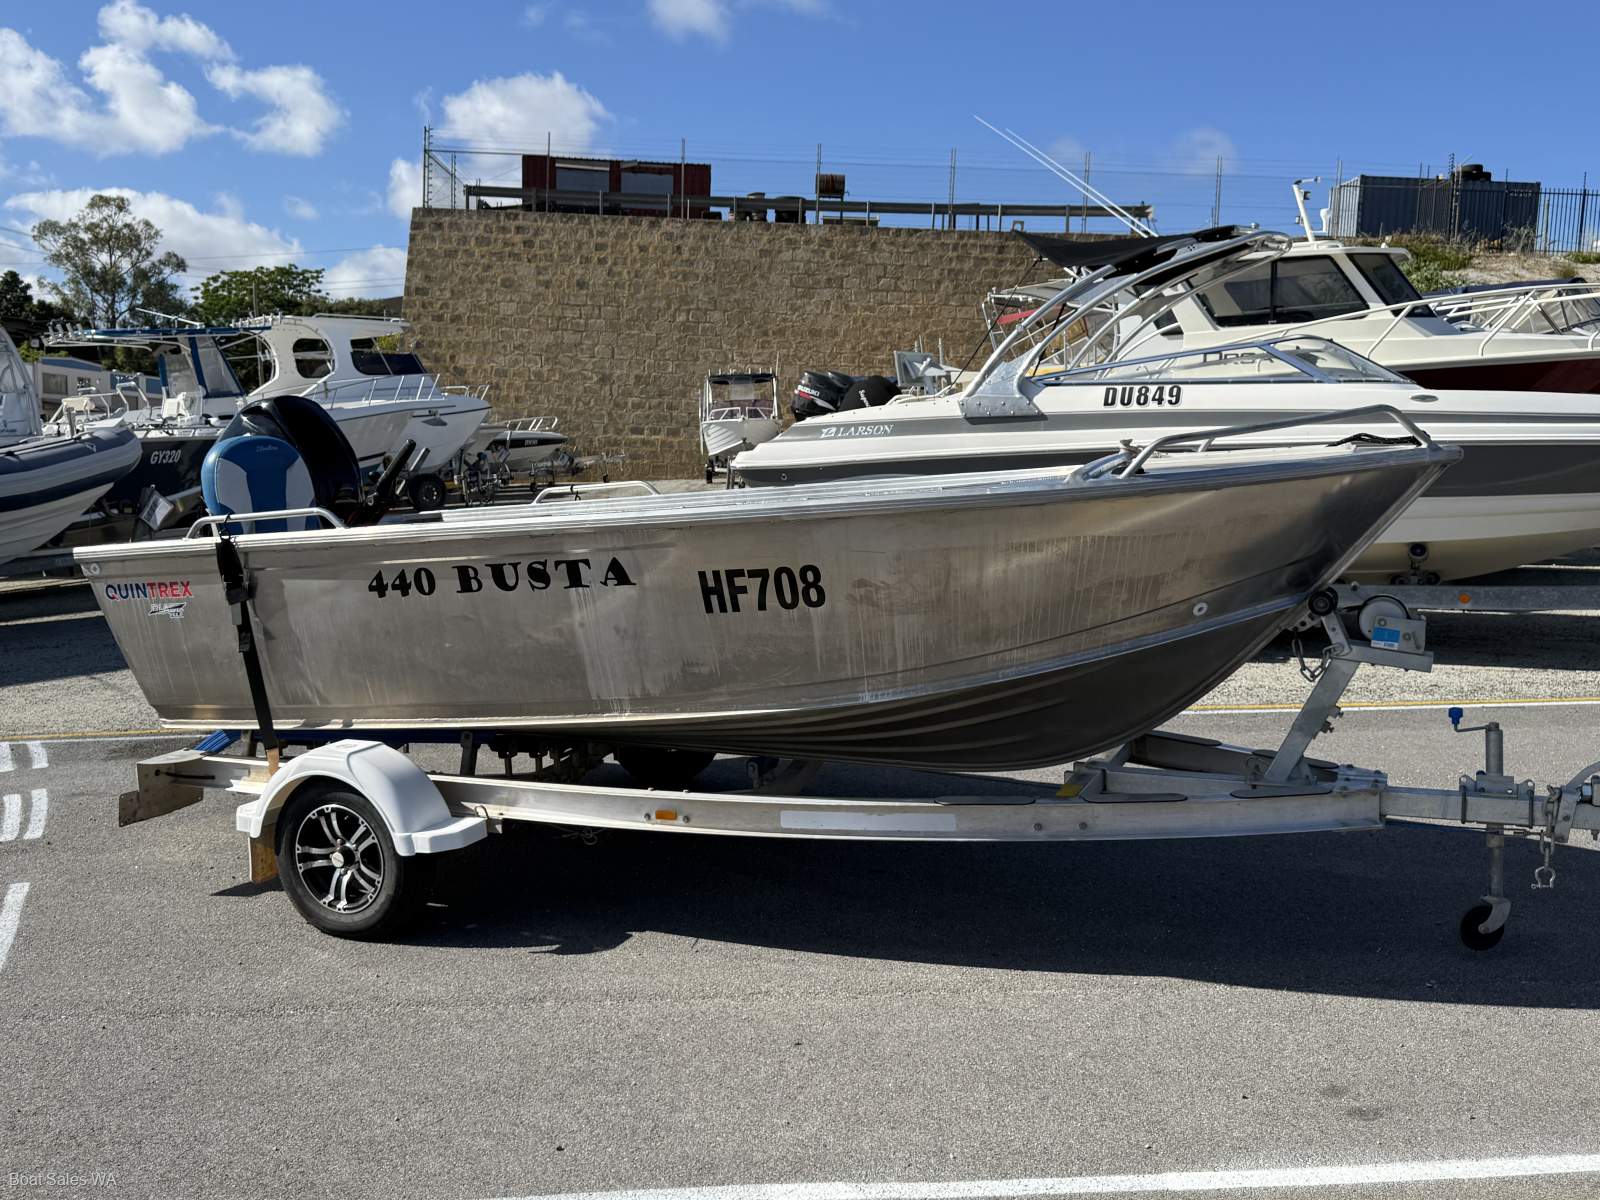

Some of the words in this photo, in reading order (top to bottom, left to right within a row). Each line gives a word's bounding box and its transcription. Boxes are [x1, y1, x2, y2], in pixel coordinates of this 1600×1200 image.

[1103, 385, 1182, 407] DU849
[838, 425, 894, 437] LARSON
[150, 449, 182, 465] GY320
[368, 567, 436, 598] 440
[452, 557, 636, 594] BUSTA
[105, 581, 193, 600] QUINTREX
[698, 564, 826, 614] HF708
